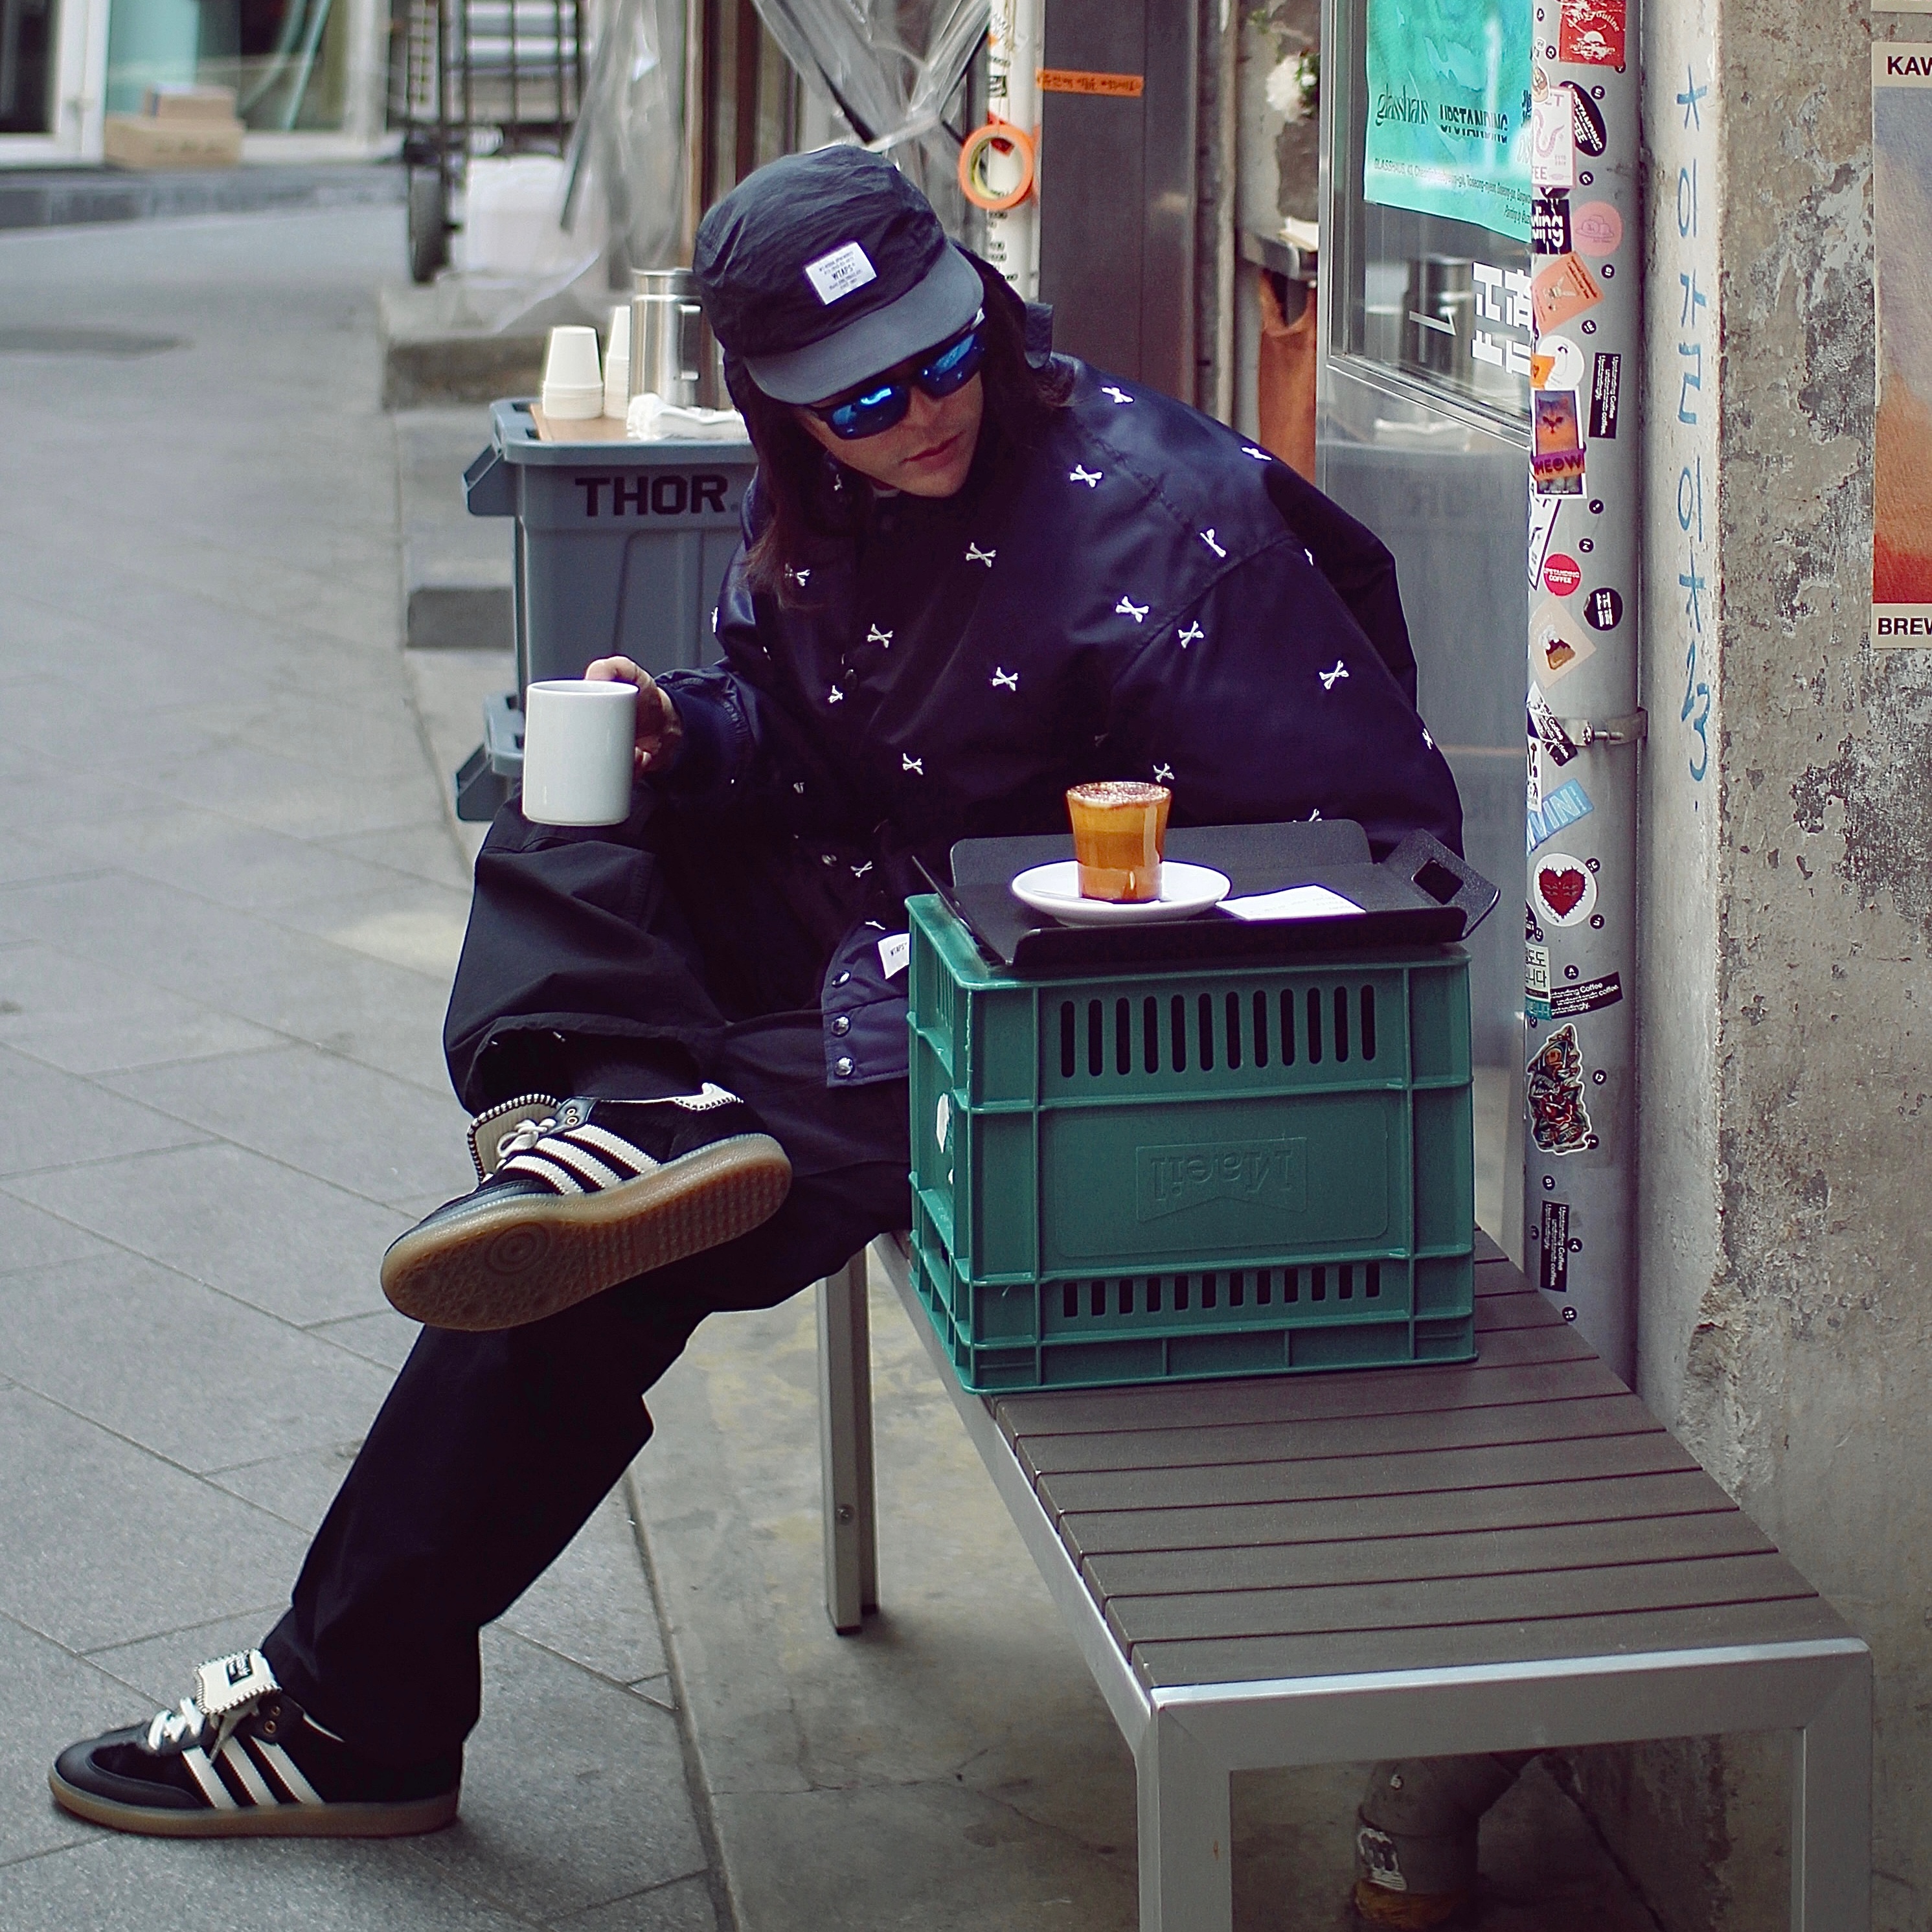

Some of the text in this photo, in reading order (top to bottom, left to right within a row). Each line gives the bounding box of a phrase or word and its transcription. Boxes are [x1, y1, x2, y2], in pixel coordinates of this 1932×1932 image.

[1534, 455, 1582, 475] MEOW
[575, 475, 727, 516] THOR
[1150, 1150, 1293, 1201] Maeil
